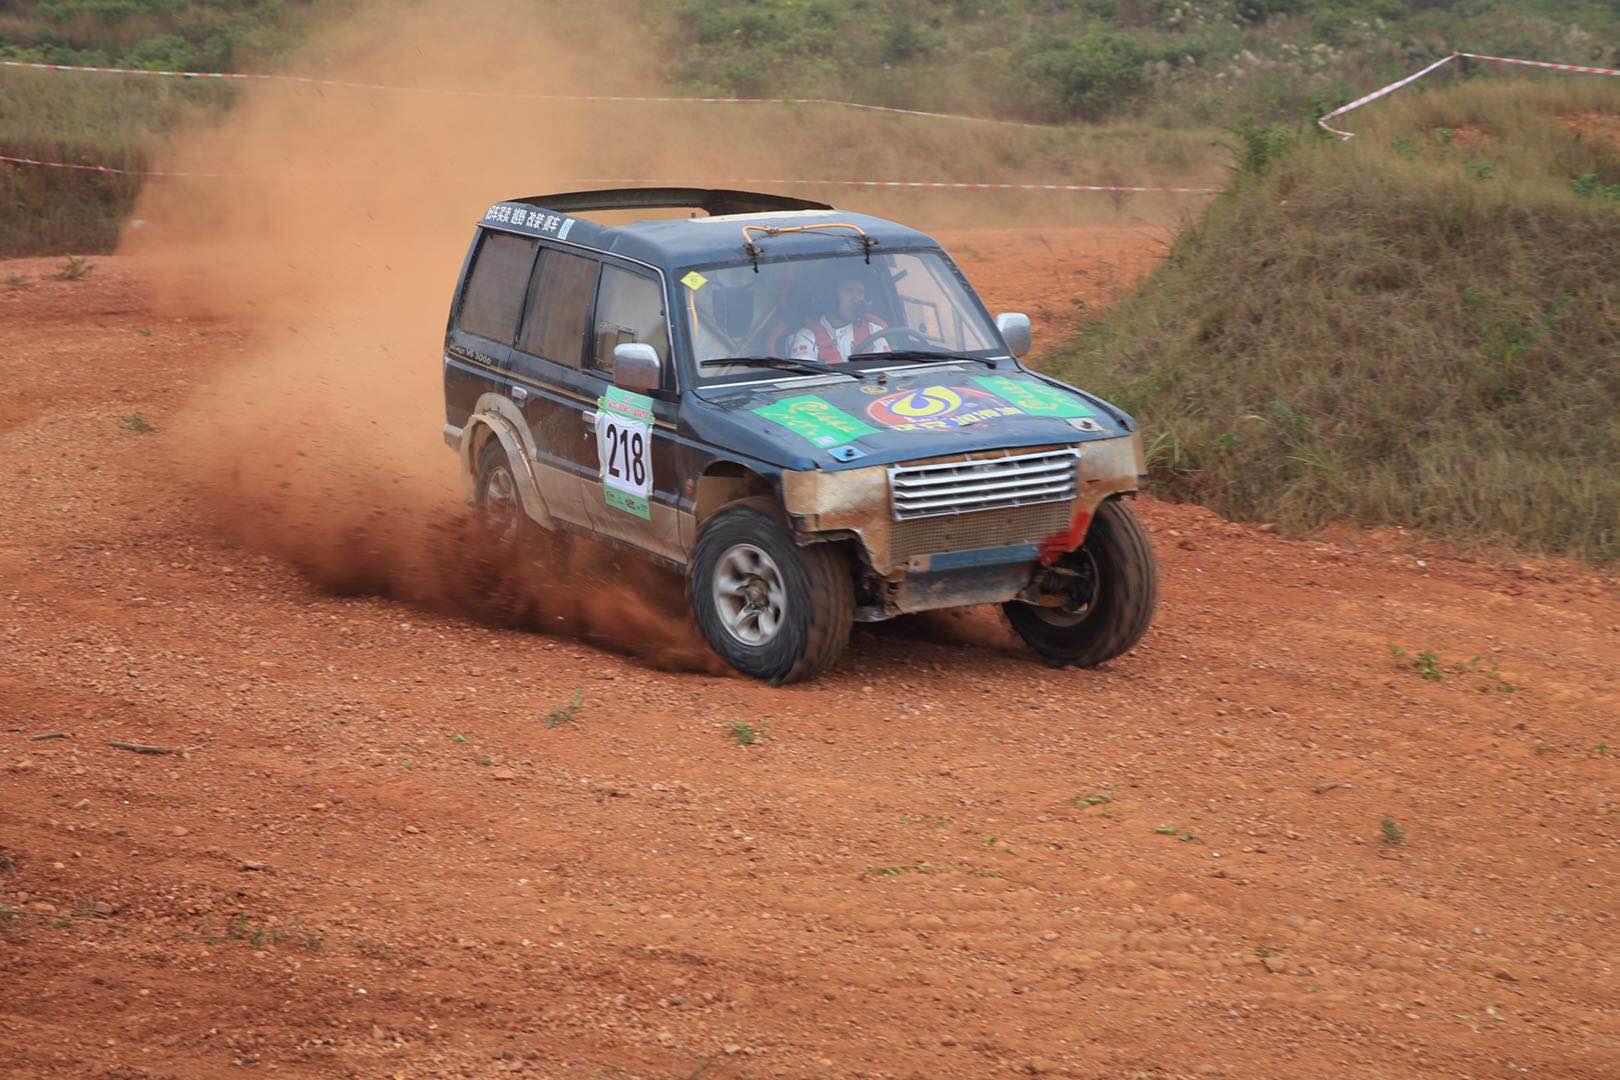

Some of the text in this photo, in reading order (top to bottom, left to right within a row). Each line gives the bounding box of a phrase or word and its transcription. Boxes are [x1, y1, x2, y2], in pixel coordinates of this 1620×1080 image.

[526, 211, 545, 229] 改装
[542, 215, 561, 232] 赛车
[475, 353, 492, 365] 3000
[606, 423, 646, 487] 218
